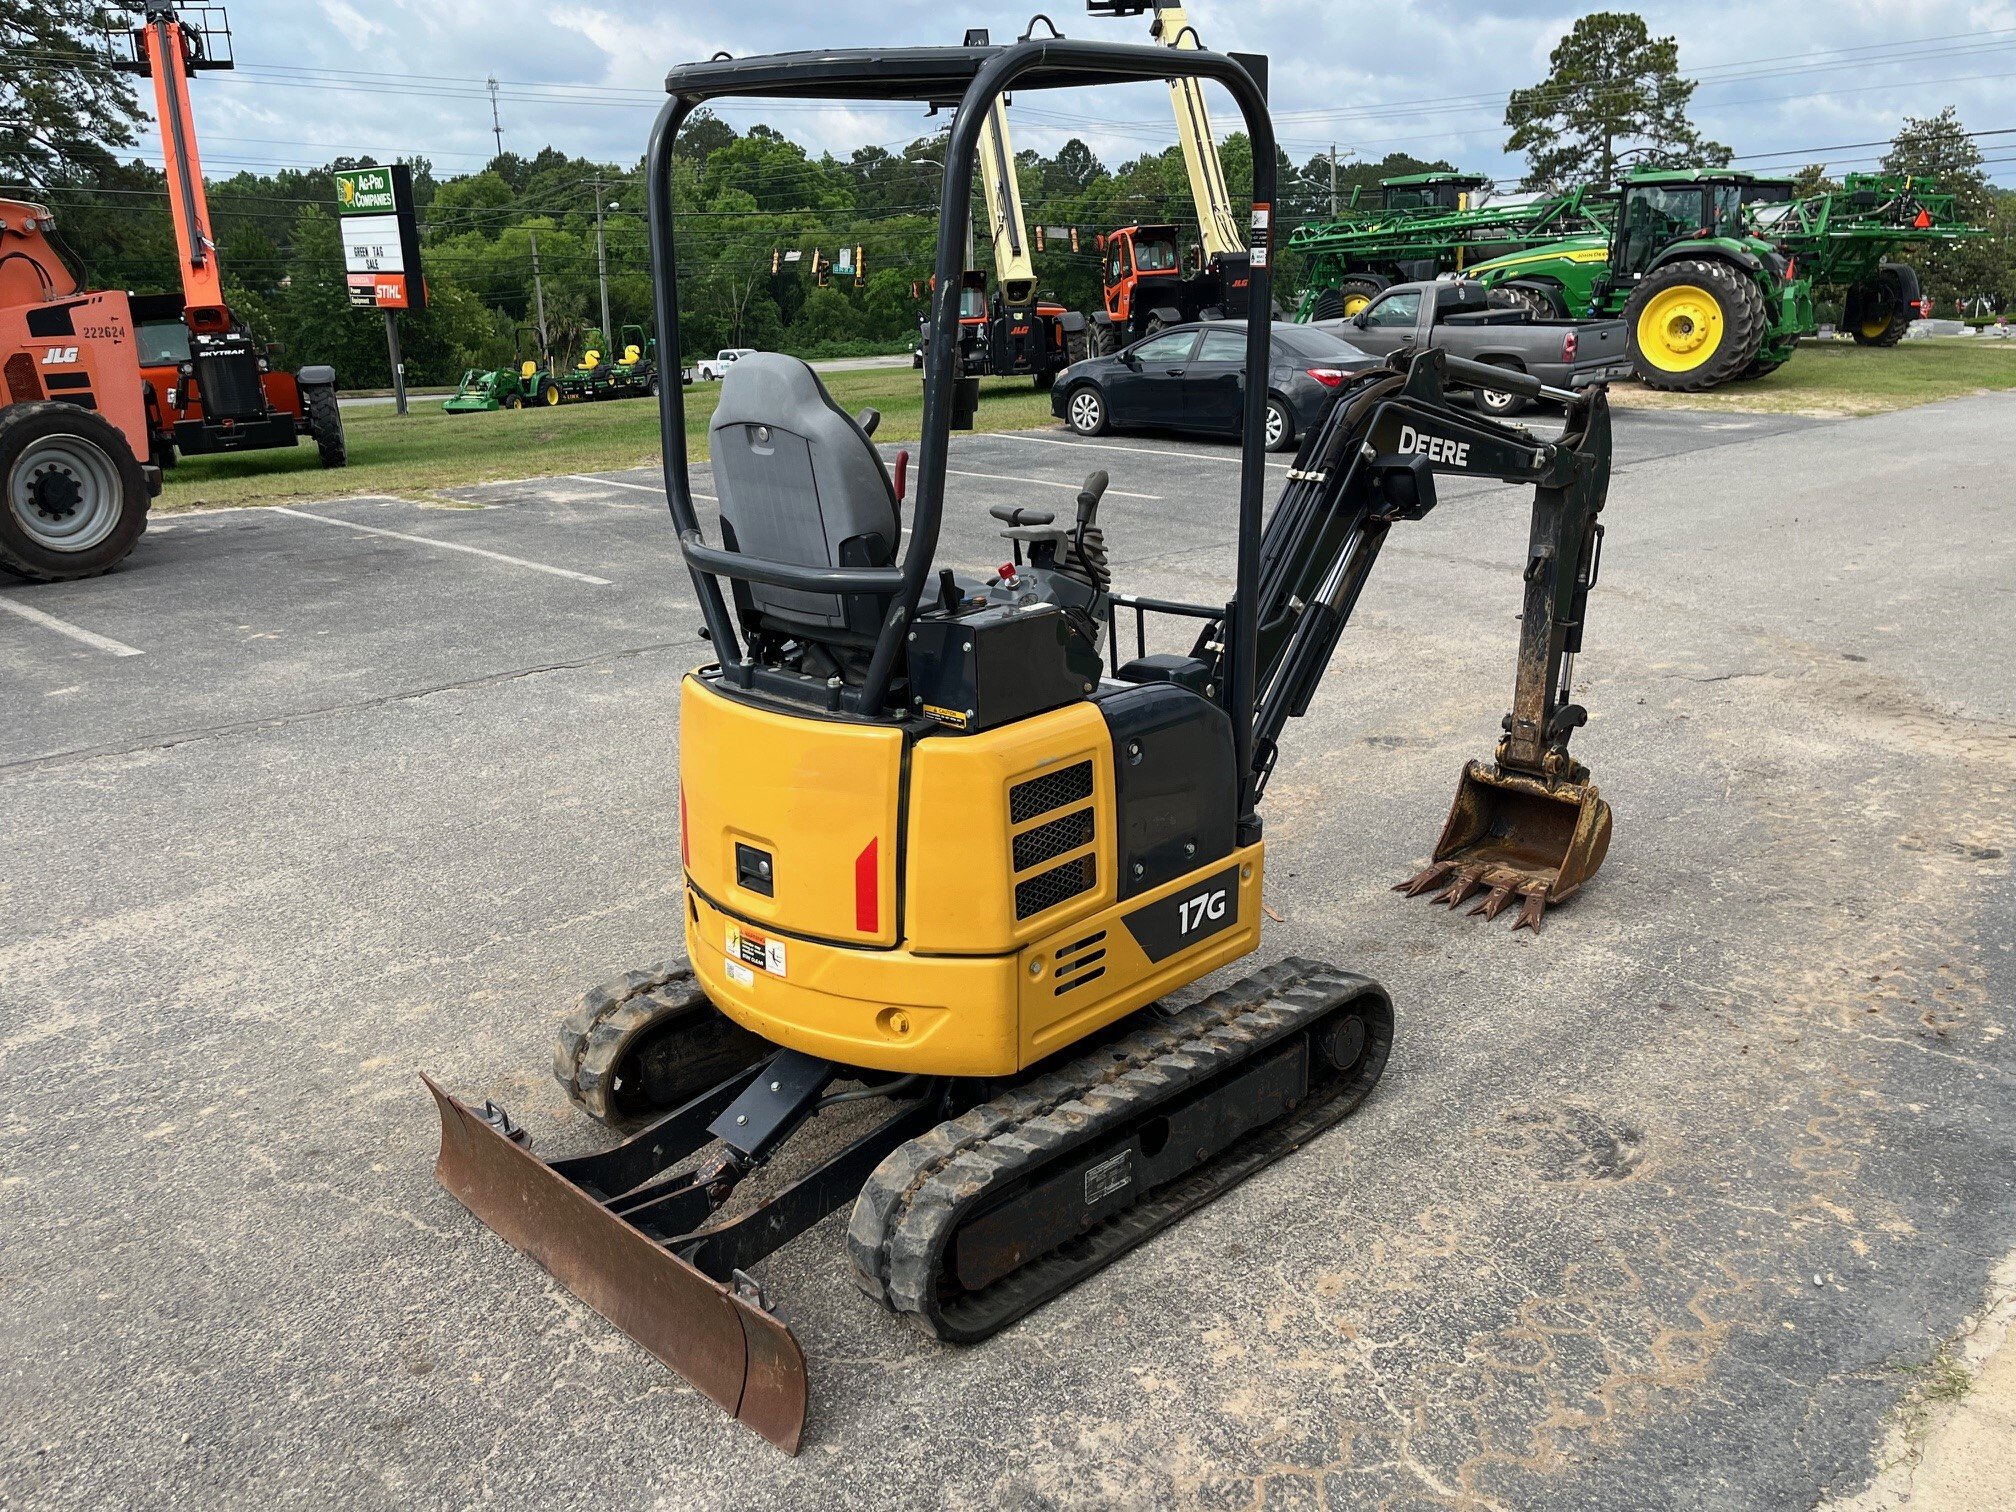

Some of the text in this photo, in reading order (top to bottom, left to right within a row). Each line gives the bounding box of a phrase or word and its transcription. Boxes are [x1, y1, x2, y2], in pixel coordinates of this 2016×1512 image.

[355, 191, 392, 208] COMPANIES
[354, 245, 384, 258] GREEN TAG
[366, 259, 379, 270] SALE
[1232, 279, 1249, 287] JLG
[376, 284, 402, 299] STIHL
[83, 326, 125, 339] 222624
[1010, 326, 1029, 335] JLG
[41, 347, 79, 365] JLG
[199, 349, 246, 357] SKYTRAK
[1398, 425, 1470, 467] DEERE
[938, 708, 957, 716] CAUTION
[1179, 890, 1226, 935] 17G
